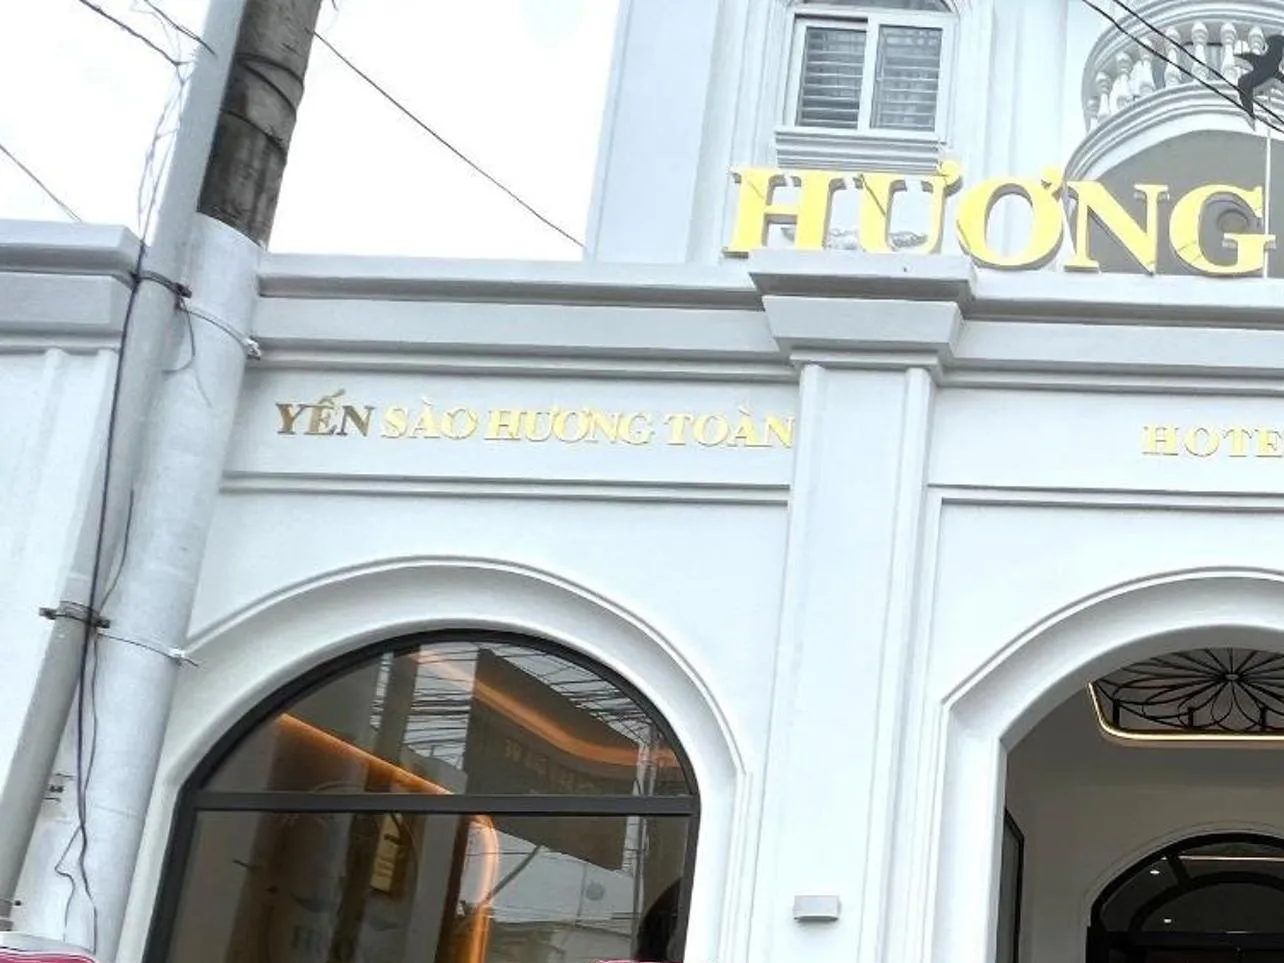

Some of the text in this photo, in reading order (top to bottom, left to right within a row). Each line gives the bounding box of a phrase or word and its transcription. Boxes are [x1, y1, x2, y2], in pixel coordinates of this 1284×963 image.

[725, 159, 1275, 277] HƯƠNG
[275, 388, 796, 448] YẾN SÀO HƯƠNG TOÀN
